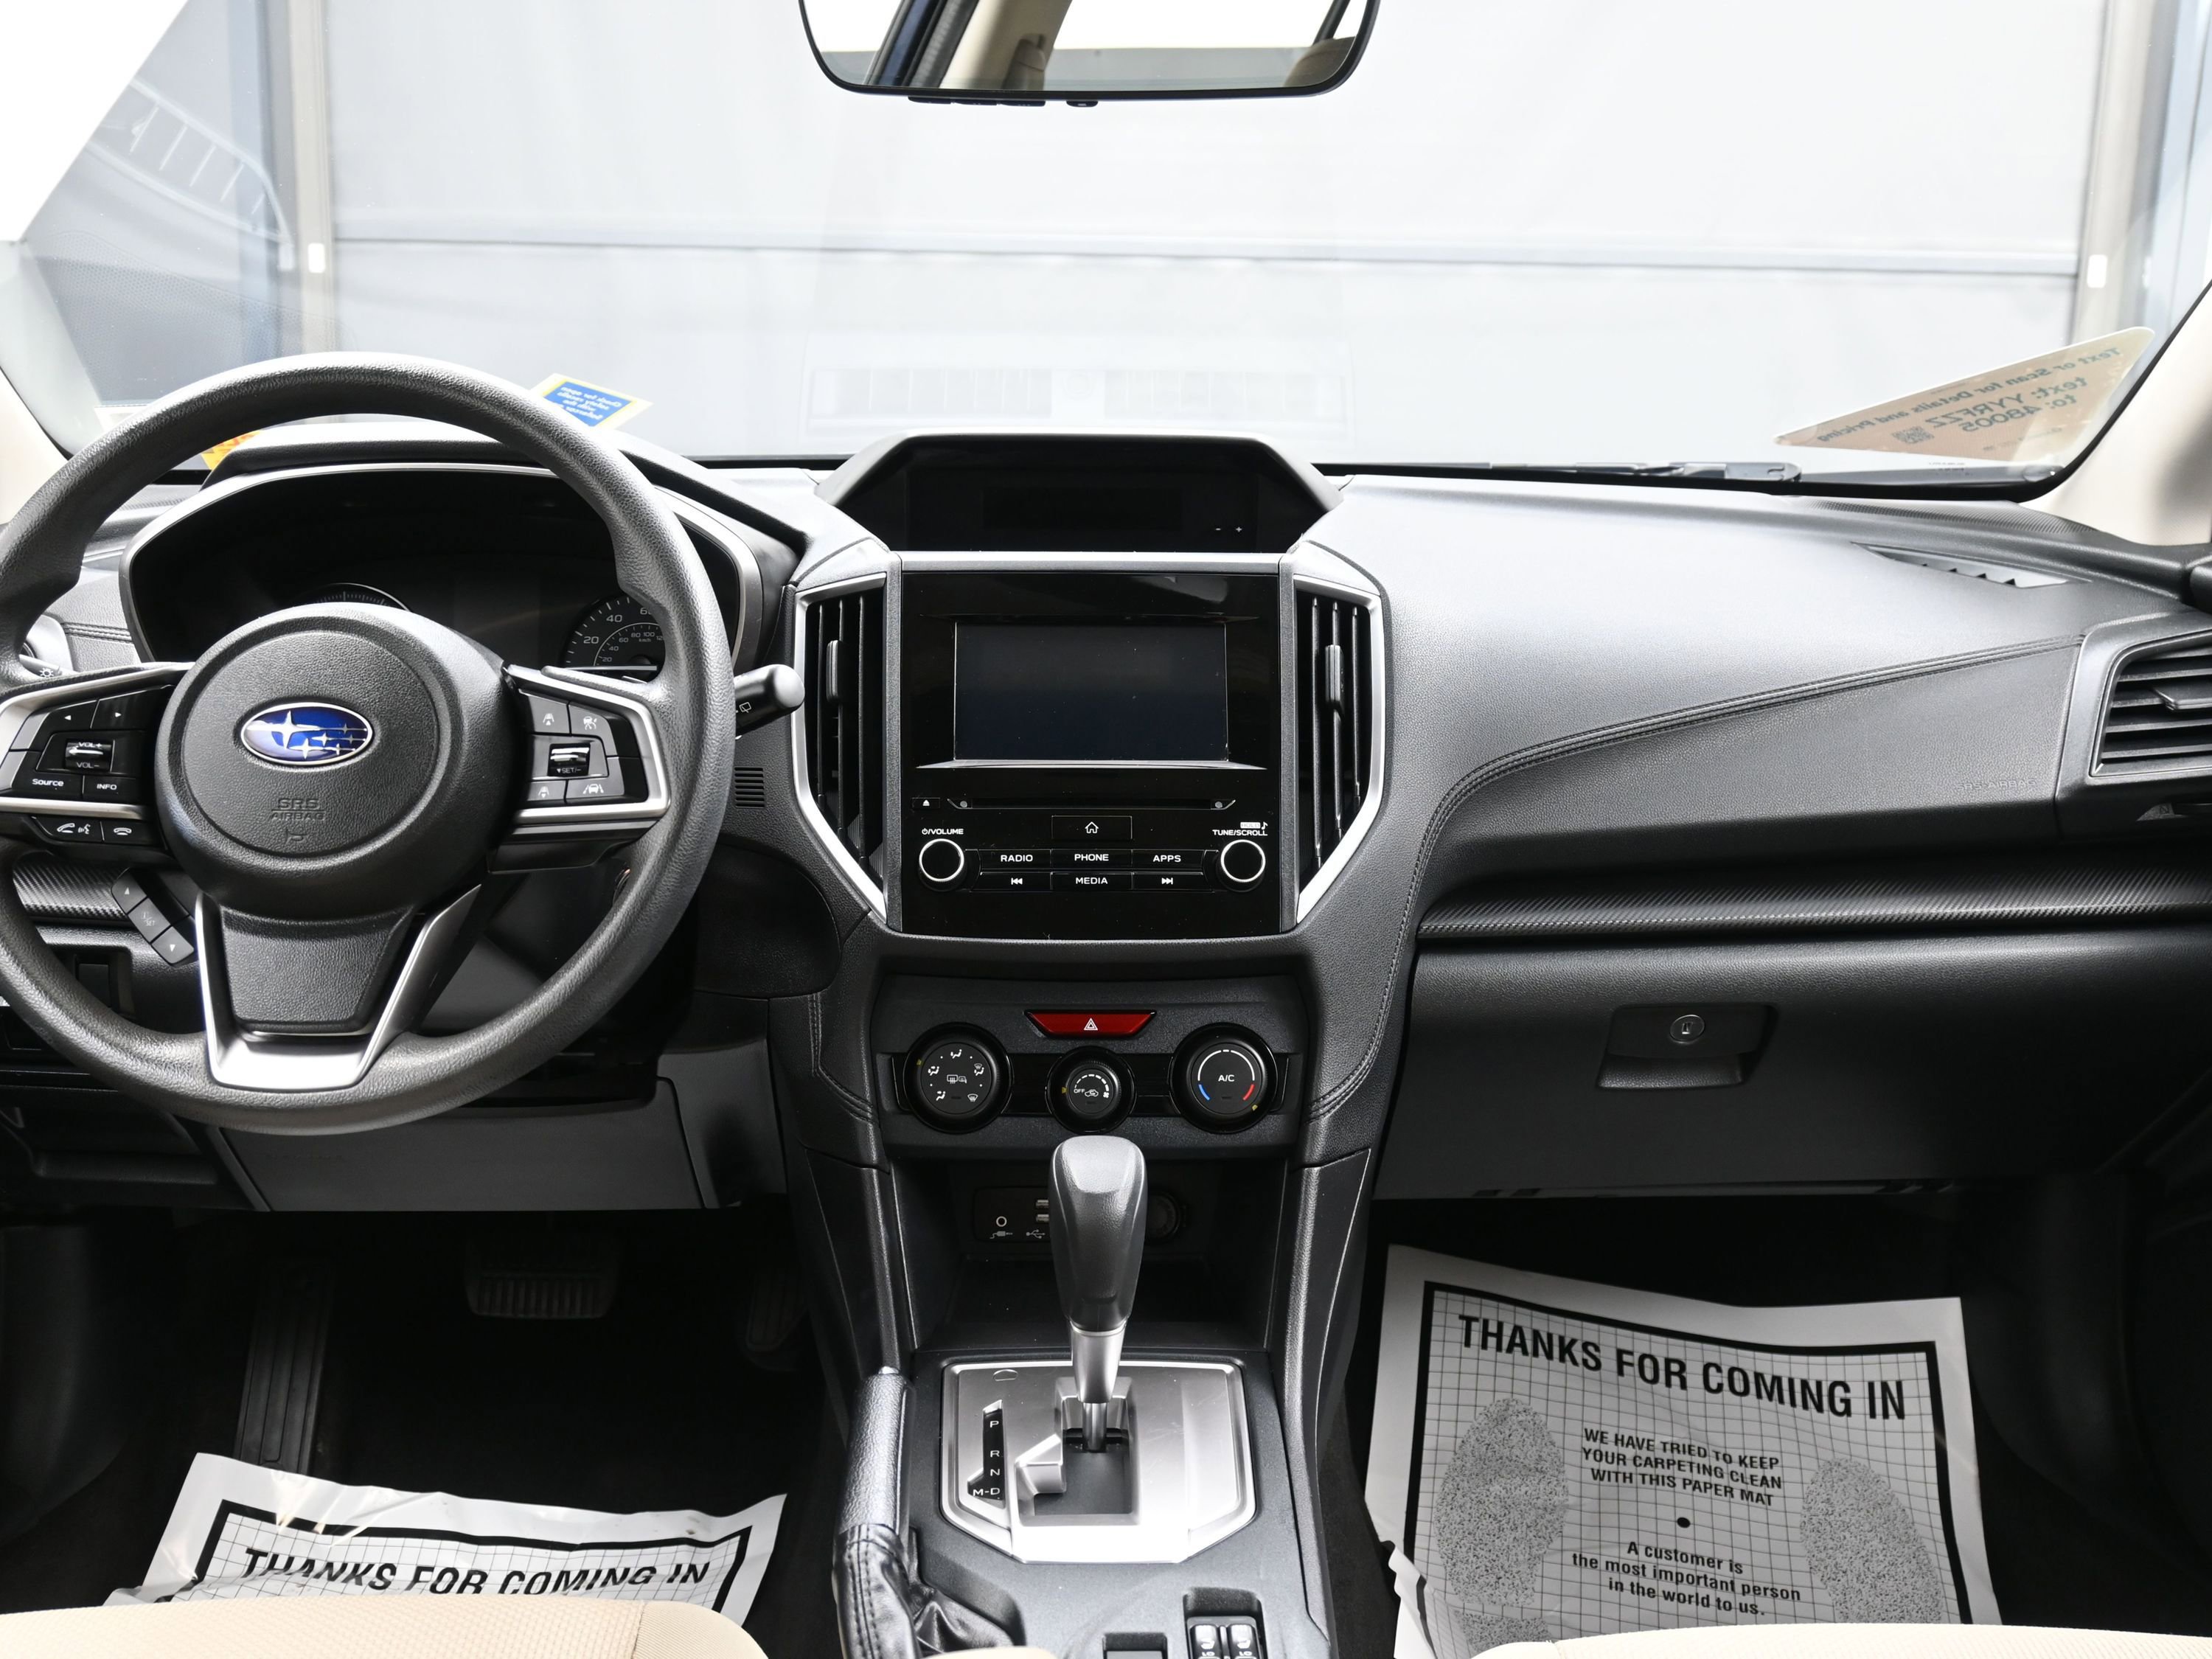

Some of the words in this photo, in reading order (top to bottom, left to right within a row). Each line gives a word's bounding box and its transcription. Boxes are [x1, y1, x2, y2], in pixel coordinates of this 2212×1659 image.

[606, 614, 622, 622] 40
[32, 779, 64, 787] Source
[271, 812, 325, 821] AIRBAG
[278, 798, 320, 810] SRS
[1458, 1315, 1602, 1371] THANKS
[1616, 1348, 1688, 1391] FOR
[1703, 1363, 1851, 1417] COMING
[1868, 1380, 1905, 1420] IN
[990, 1450, 1000, 1458] R
[1585, 1428, 1608, 1444] WE
[1615, 1433, 1655, 1451] HAVE
[1660, 1441, 1707, 1458] TRIED
[1713, 1450, 1732, 1464] TO
[1739, 1455, 1779, 1470] KEEP
[990, 1468, 1000, 1476] N
[1582, 1447, 1627, 1466] YOUR
[1633, 1455, 1724, 1479] CARPETING
[1730, 1470, 1781, 1489] CLEAN
[1591, 1468, 1633, 1484] WITH
[1639, 1472, 1677, 1488] THIS
[1683, 1478, 1734, 1498] PAPER
[1740, 1489, 1773, 1506] MAT
[241, 1548, 397, 1590] THANKS
[405, 1565, 488, 1595] FOR
[498, 1566, 657, 1595] COMING
[666, 1562, 710, 1584] IN
[1627, 1541, 1639, 1555] A
[1644, 1545, 1723, 1570] customer
[1729, 1559, 1743, 1574] is
[1572, 1553, 1599, 1569] the
[1605, 1559, 1647, 1577] most
[1652, 1565, 1736, 1592] important
[1741, 1583, 1801, 1601] person
[1609, 1577, 1624, 1592] in
[1630, 1582, 1656, 1599] the
[1662, 1589, 1710, 1608] world
[1716, 1597, 1732, 1612] to
[1739, 1601, 1764, 1615] us.
